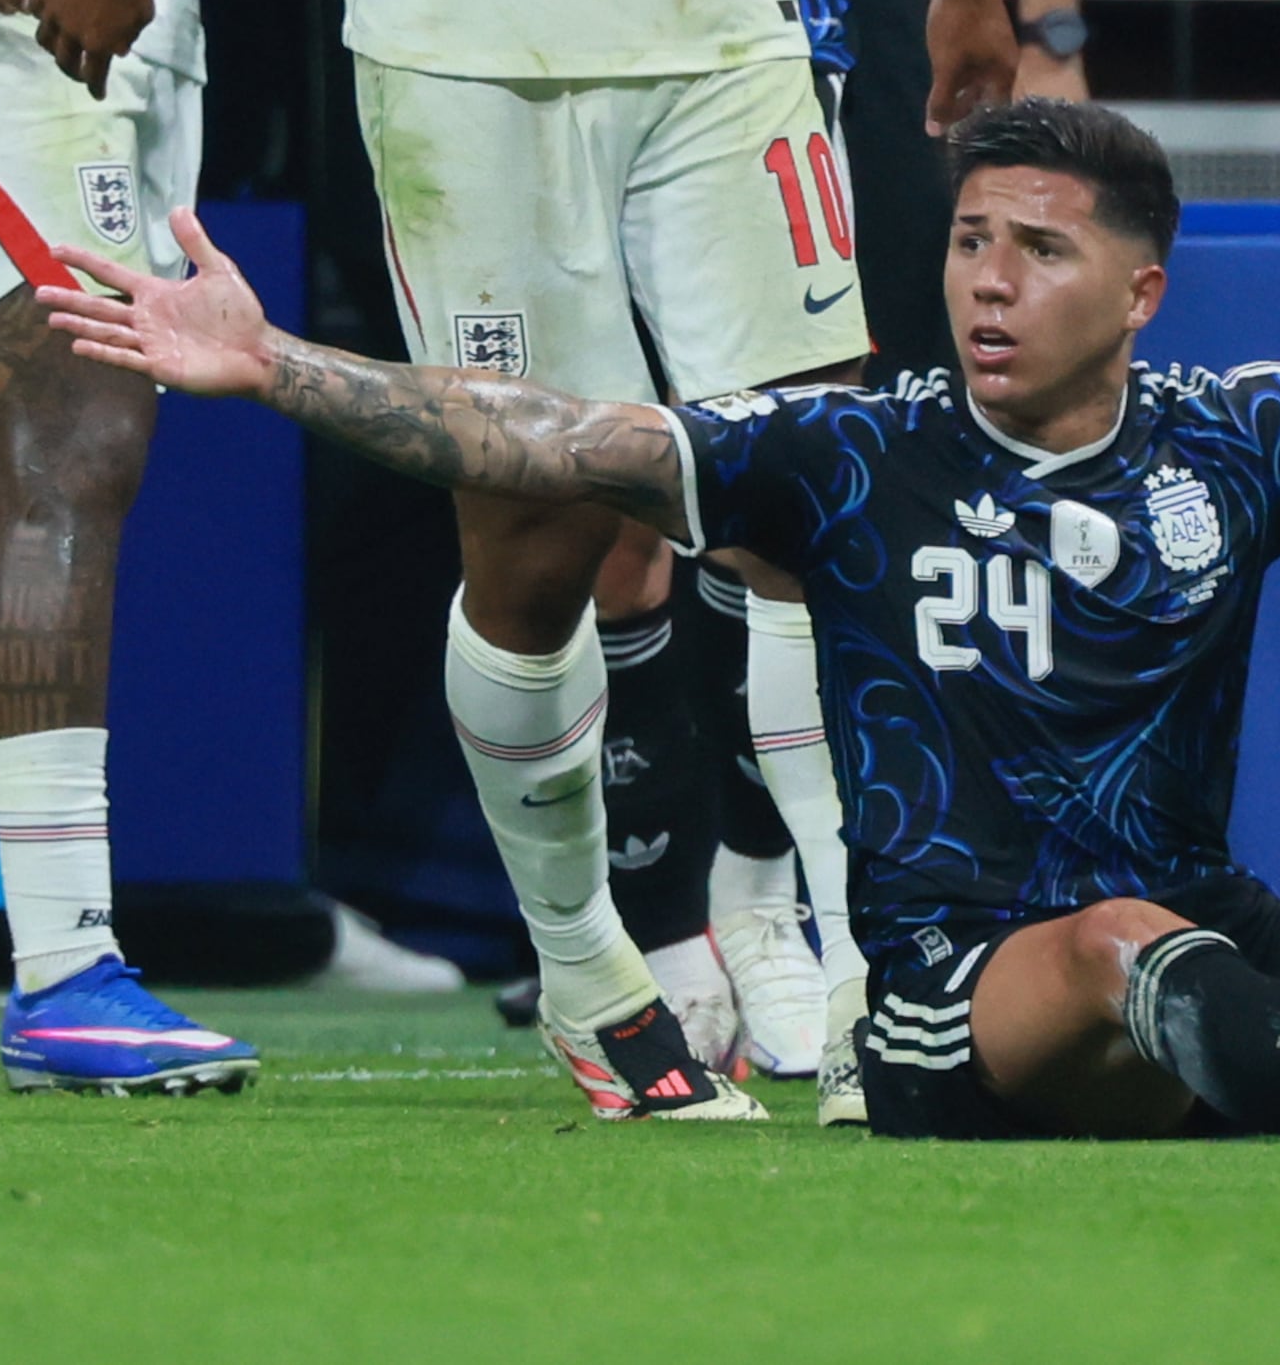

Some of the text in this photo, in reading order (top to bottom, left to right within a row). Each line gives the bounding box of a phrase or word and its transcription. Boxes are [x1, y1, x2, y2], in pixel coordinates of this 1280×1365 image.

[763, 132, 852, 268] 10
[912, 546, 1054, 682] 24
[1072, 554, 1102, 565] FIFA
